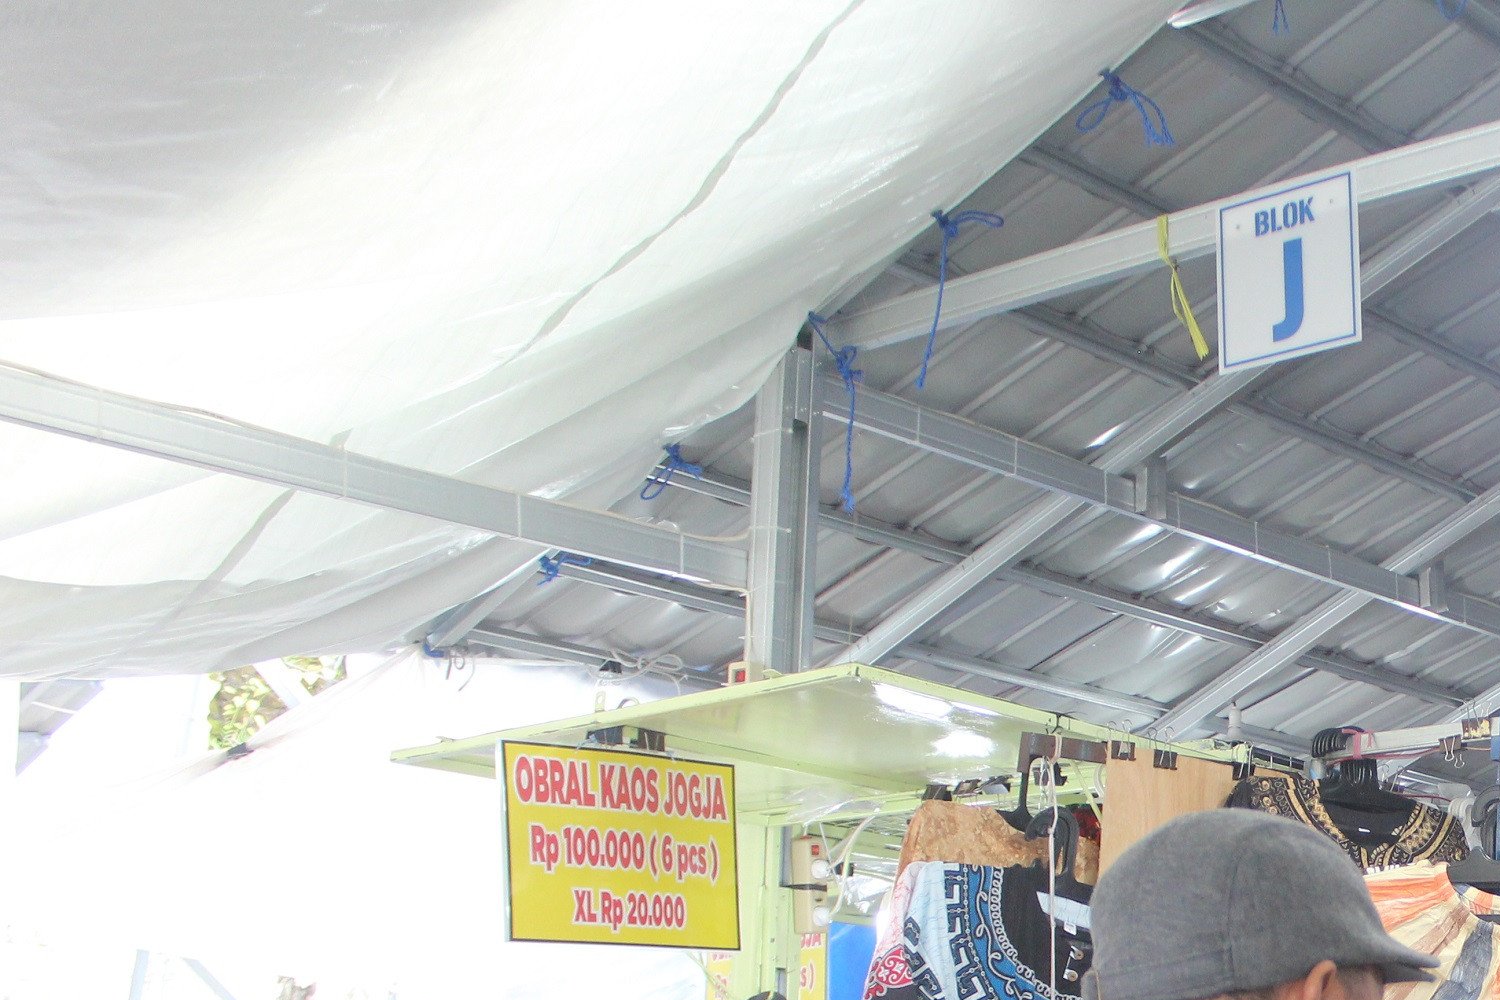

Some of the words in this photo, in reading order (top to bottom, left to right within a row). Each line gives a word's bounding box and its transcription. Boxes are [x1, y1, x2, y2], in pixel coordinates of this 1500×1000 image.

[1254, 197, 1315, 237] BLOK
[1272, 237, 1304, 342] J
[516, 756, 595, 807] OBRAL
[600, 764, 659, 814] KAOS
[664, 771, 727, 820] JOGJA
[531, 825, 558, 871] Rp
[563, 827, 645, 869] 100.000
[574, 890, 596, 922] XL
[601, 892, 623, 931] Rp
[627, 893, 685, 928] 20.000
